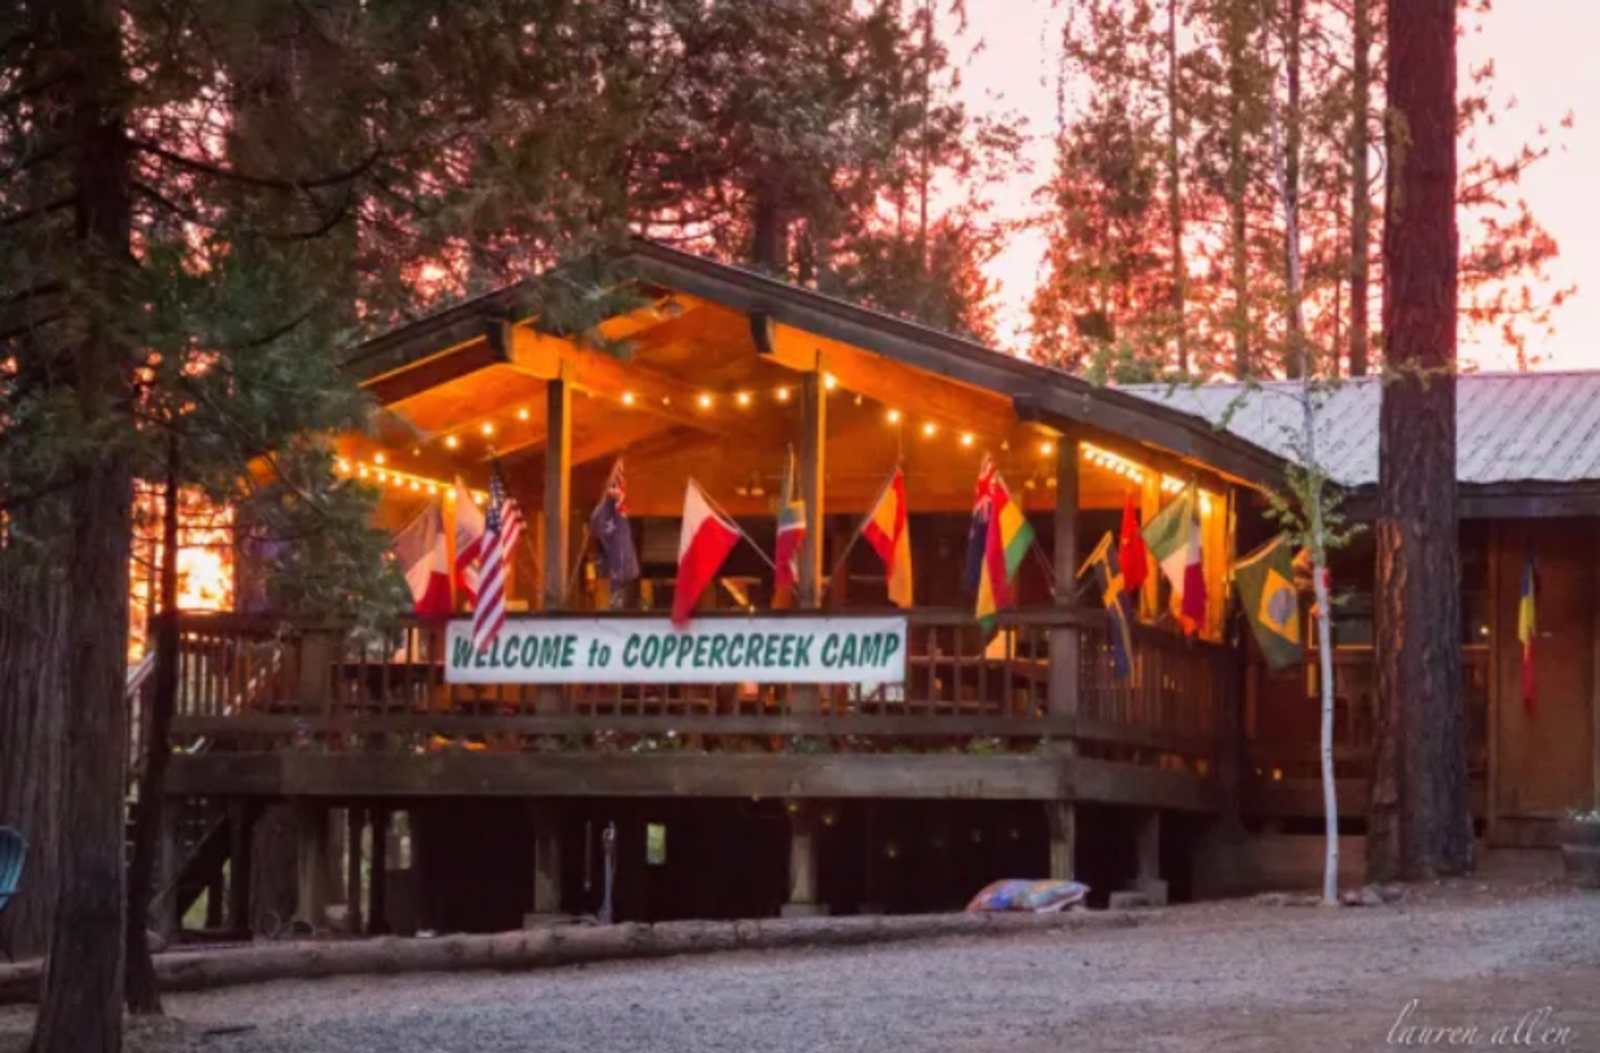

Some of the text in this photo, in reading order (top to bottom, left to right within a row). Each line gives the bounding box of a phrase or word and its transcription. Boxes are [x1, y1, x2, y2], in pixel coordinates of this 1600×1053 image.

[452, 632, 900, 669] WELCOME to COPPERCREEK CAMP
